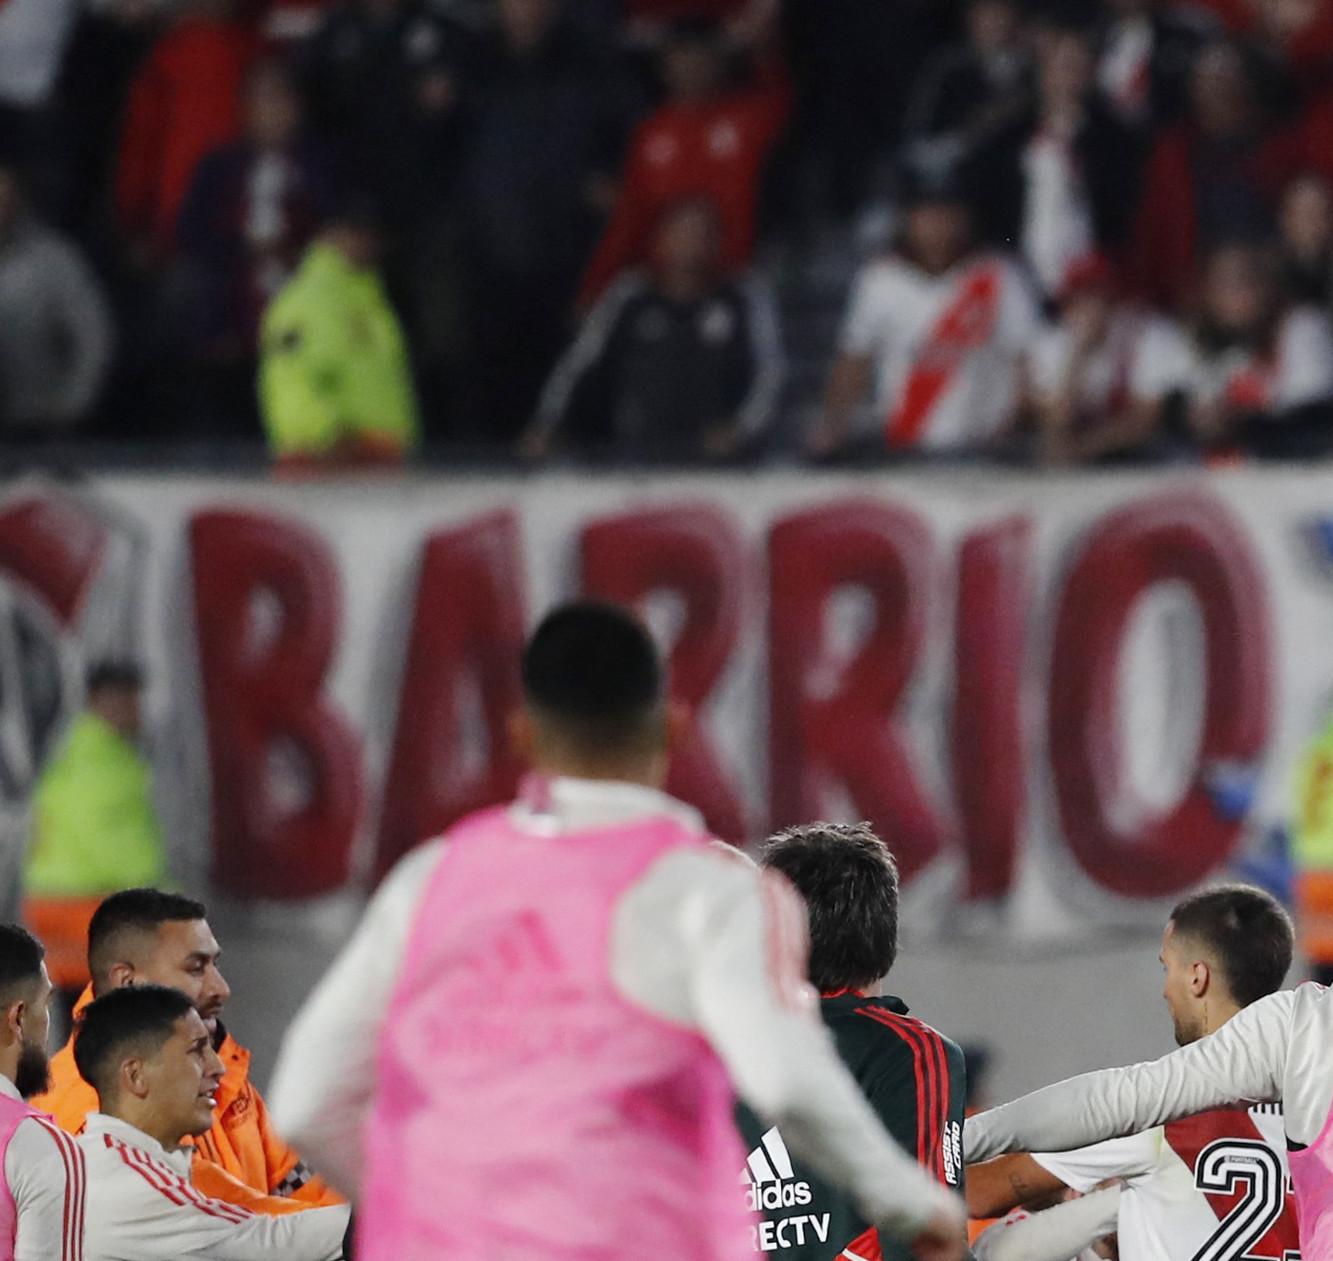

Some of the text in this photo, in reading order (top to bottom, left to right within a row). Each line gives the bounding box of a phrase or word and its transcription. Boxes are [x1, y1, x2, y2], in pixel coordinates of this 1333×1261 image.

[188, 478, 1280, 902] BARRIO
[942, 1120, 958, 1185] ASSIST
[951, 1120, 961, 1170] CARD
[744, 1178, 812, 1212] didas
[752, 1213, 831, 1252] ECTV
